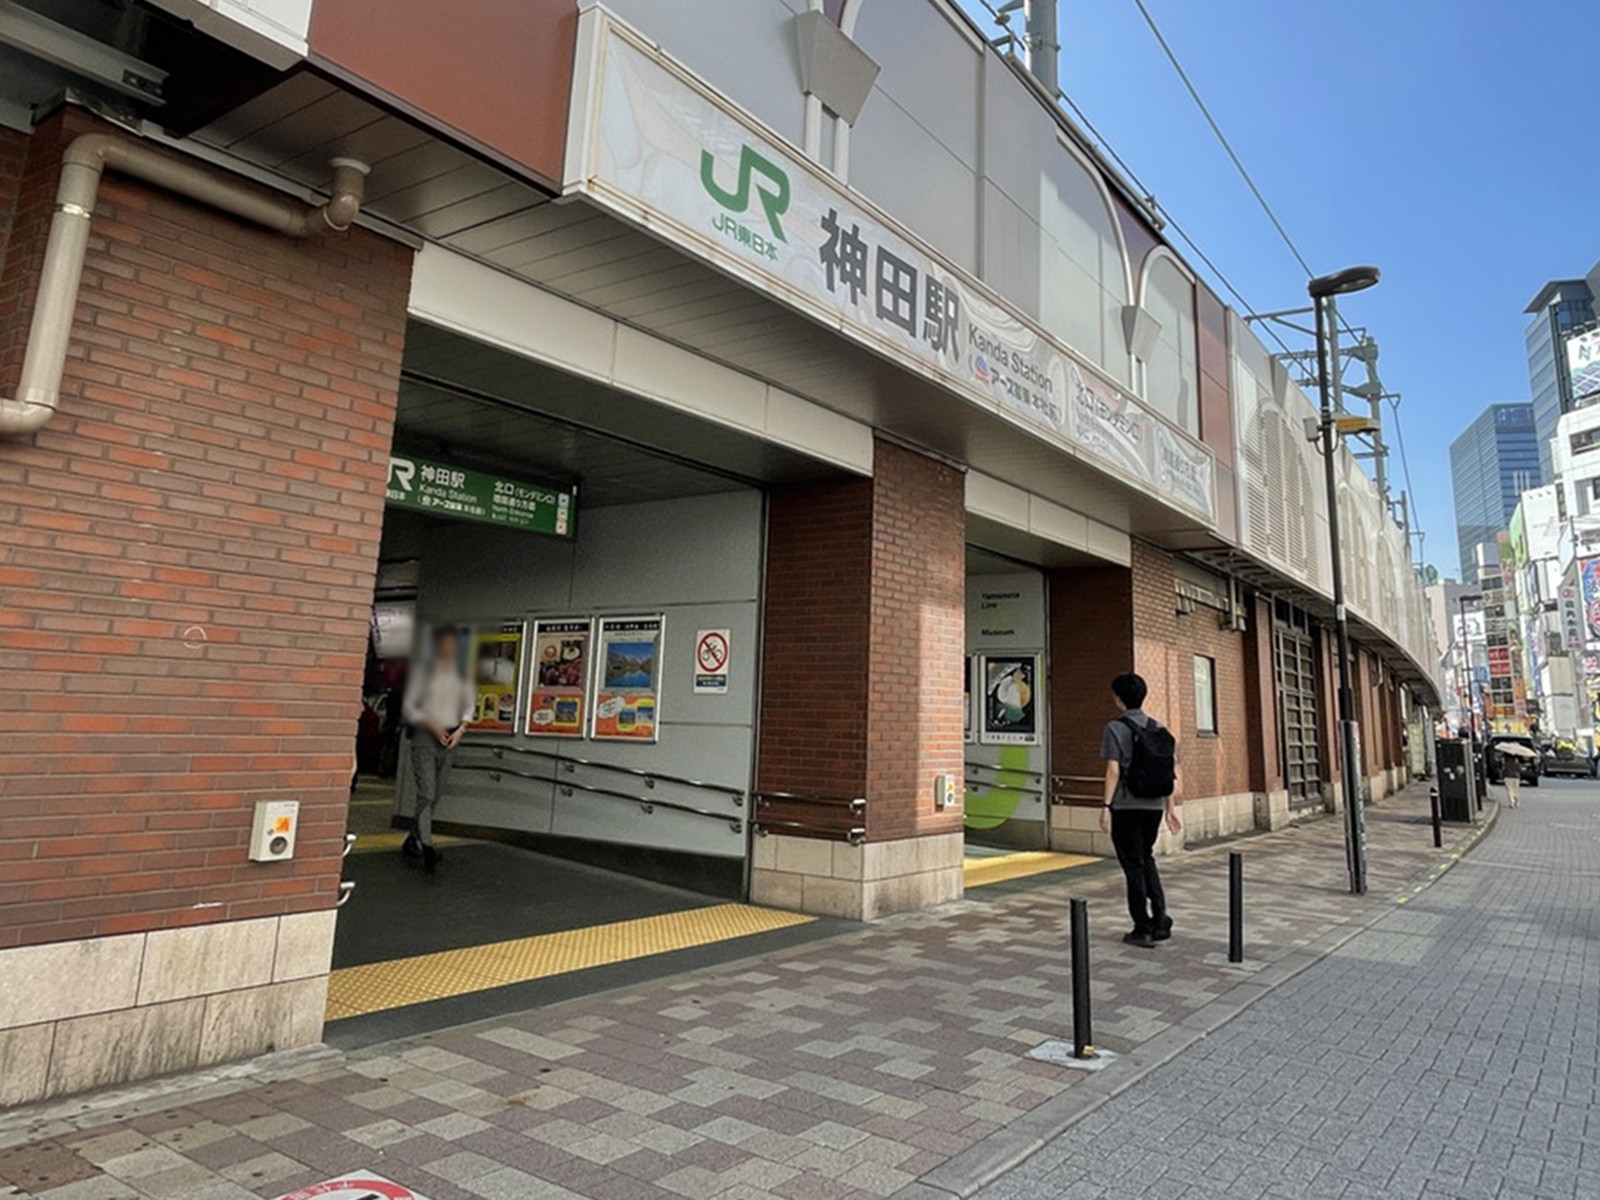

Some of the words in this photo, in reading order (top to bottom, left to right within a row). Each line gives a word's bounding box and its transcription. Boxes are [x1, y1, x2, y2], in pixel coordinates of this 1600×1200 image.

[699, 143, 788, 244] JR
[711, 212, 779, 262] JR東日本
[818, 207, 960, 361] 神田駅
[968, 325, 1009, 368] Kanda
[1010, 352, 1054, 394] Station
[419, 483, 448, 499] Kanda
[448, 488, 478, 504] Station
[420, 464, 466, 489] 神田駅
